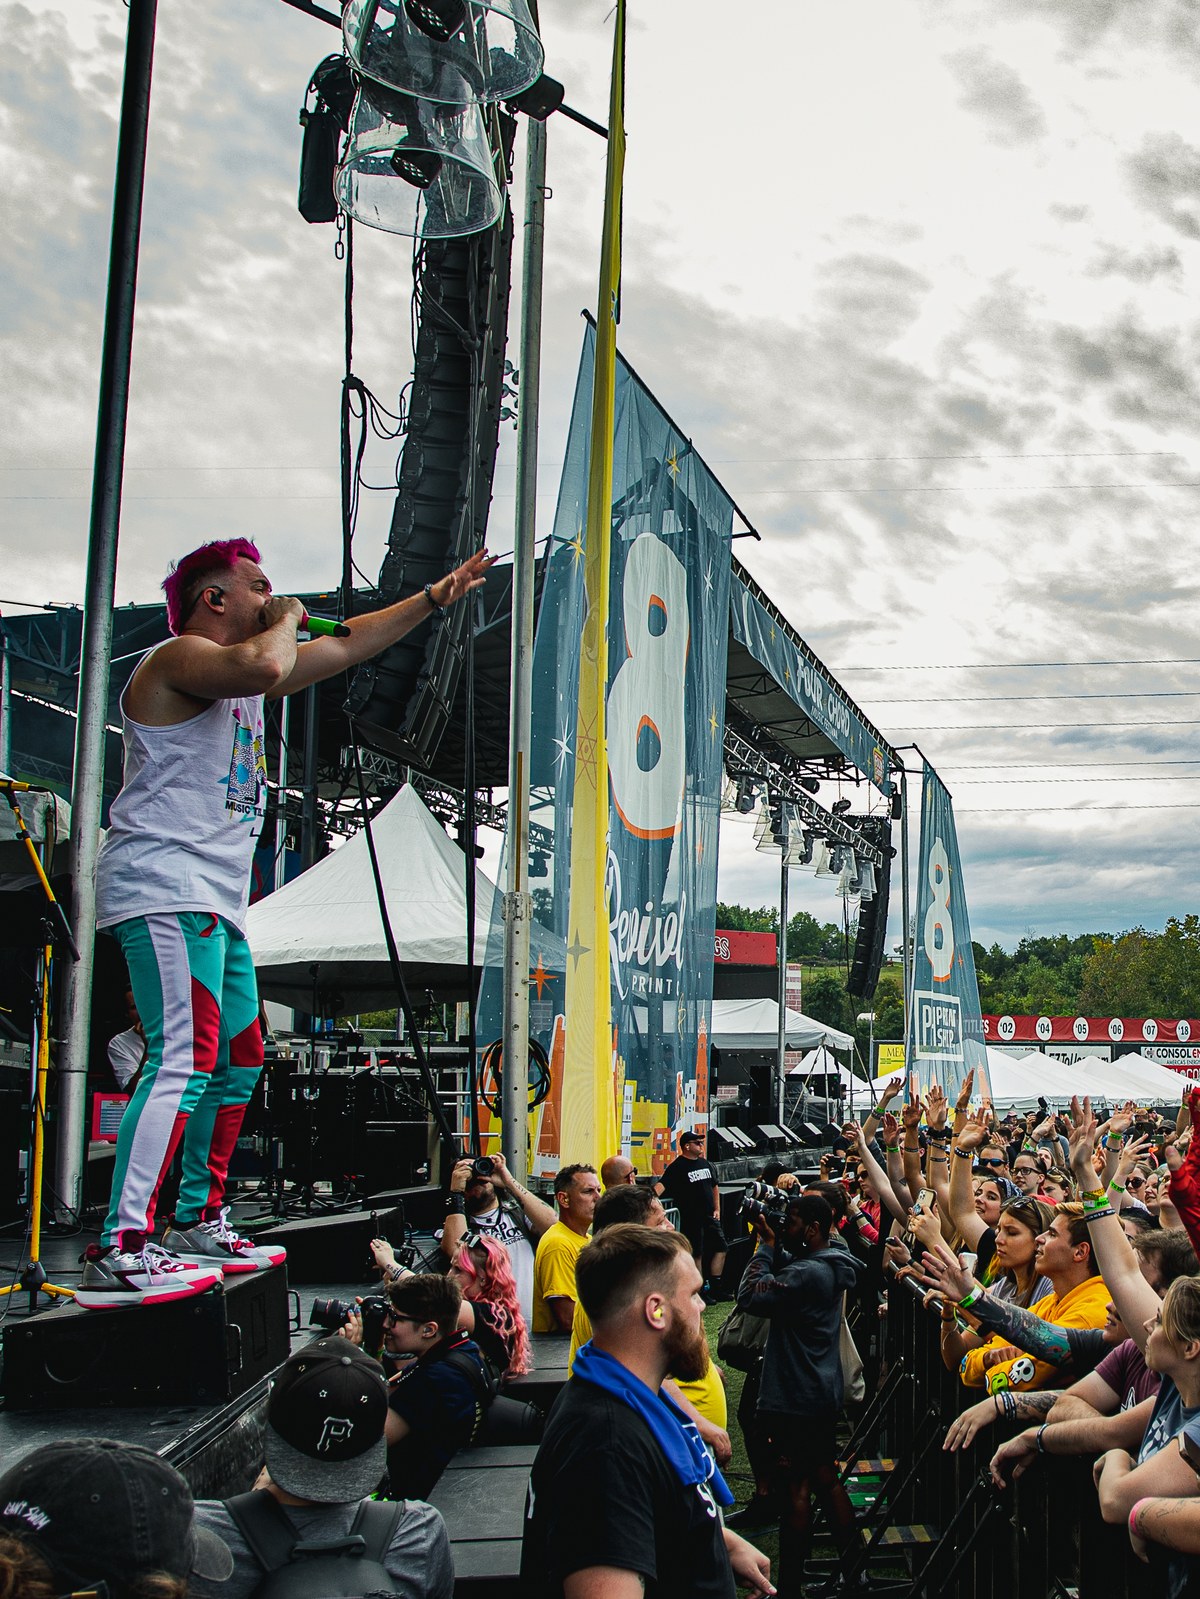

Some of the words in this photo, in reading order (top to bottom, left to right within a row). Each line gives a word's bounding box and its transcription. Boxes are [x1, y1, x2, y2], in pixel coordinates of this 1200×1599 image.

[607, 532, 690, 839] 8
[796, 653, 823, 711] FOUR
[827, 693, 851, 738] CHORD
[225, 800, 251, 815] MUSIC
[924, 836, 955, 982] 8
[631, 974, 673, 996] PRINT
[1156, 1048, 1191, 1059] CONSOL
[687, 1168, 712, 1183] SECURITY
[316, 1416, 354, 1452] P
